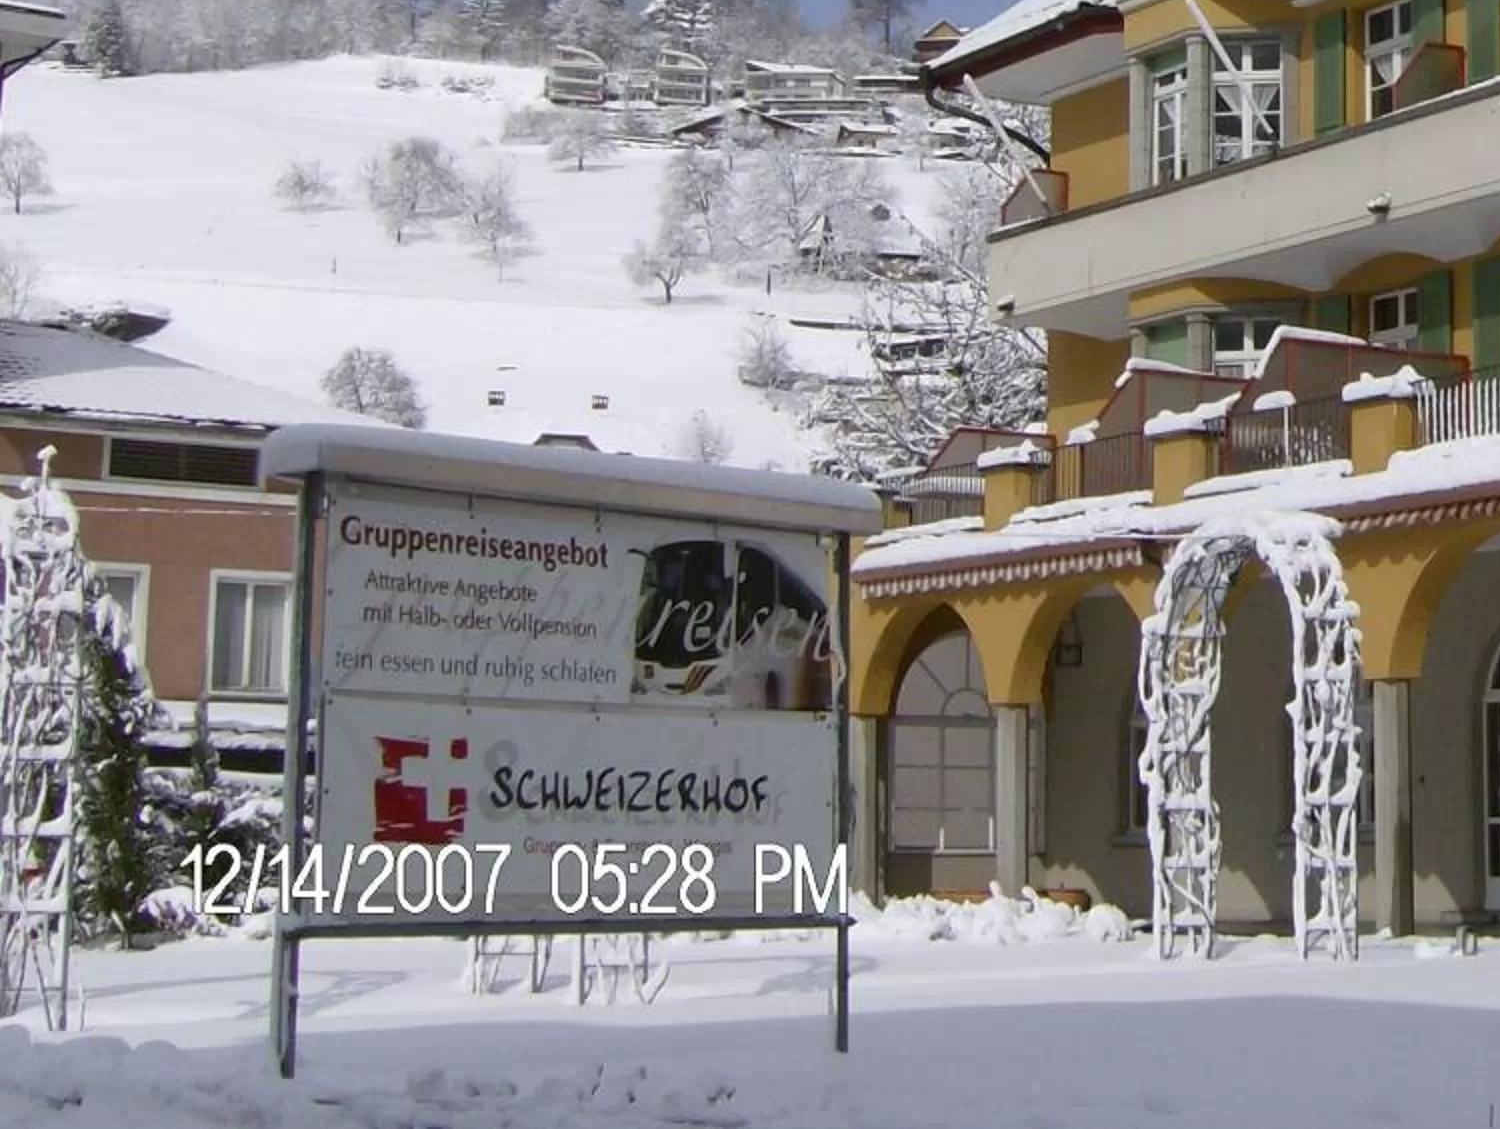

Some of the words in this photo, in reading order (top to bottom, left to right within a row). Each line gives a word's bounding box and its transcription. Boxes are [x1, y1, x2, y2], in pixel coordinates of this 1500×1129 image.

[340, 515, 609, 572] Gruppenreiseangebot
[364, 569, 450, 597] Attraktive
[453, 578, 538, 605] Angebote
[362, 602, 393, 623] mit
[399, 604, 449, 628] Halb-
[452, 607, 494, 631] oder
[498, 611, 598, 640] Vollpension
[380, 651, 435, 673] essen
[440, 654, 479, 677] und
[484, 655, 536, 686] ruhig
[540, 659, 618, 686] schlafen
[489, 766, 769, 813] SCHWEIZERHOF
